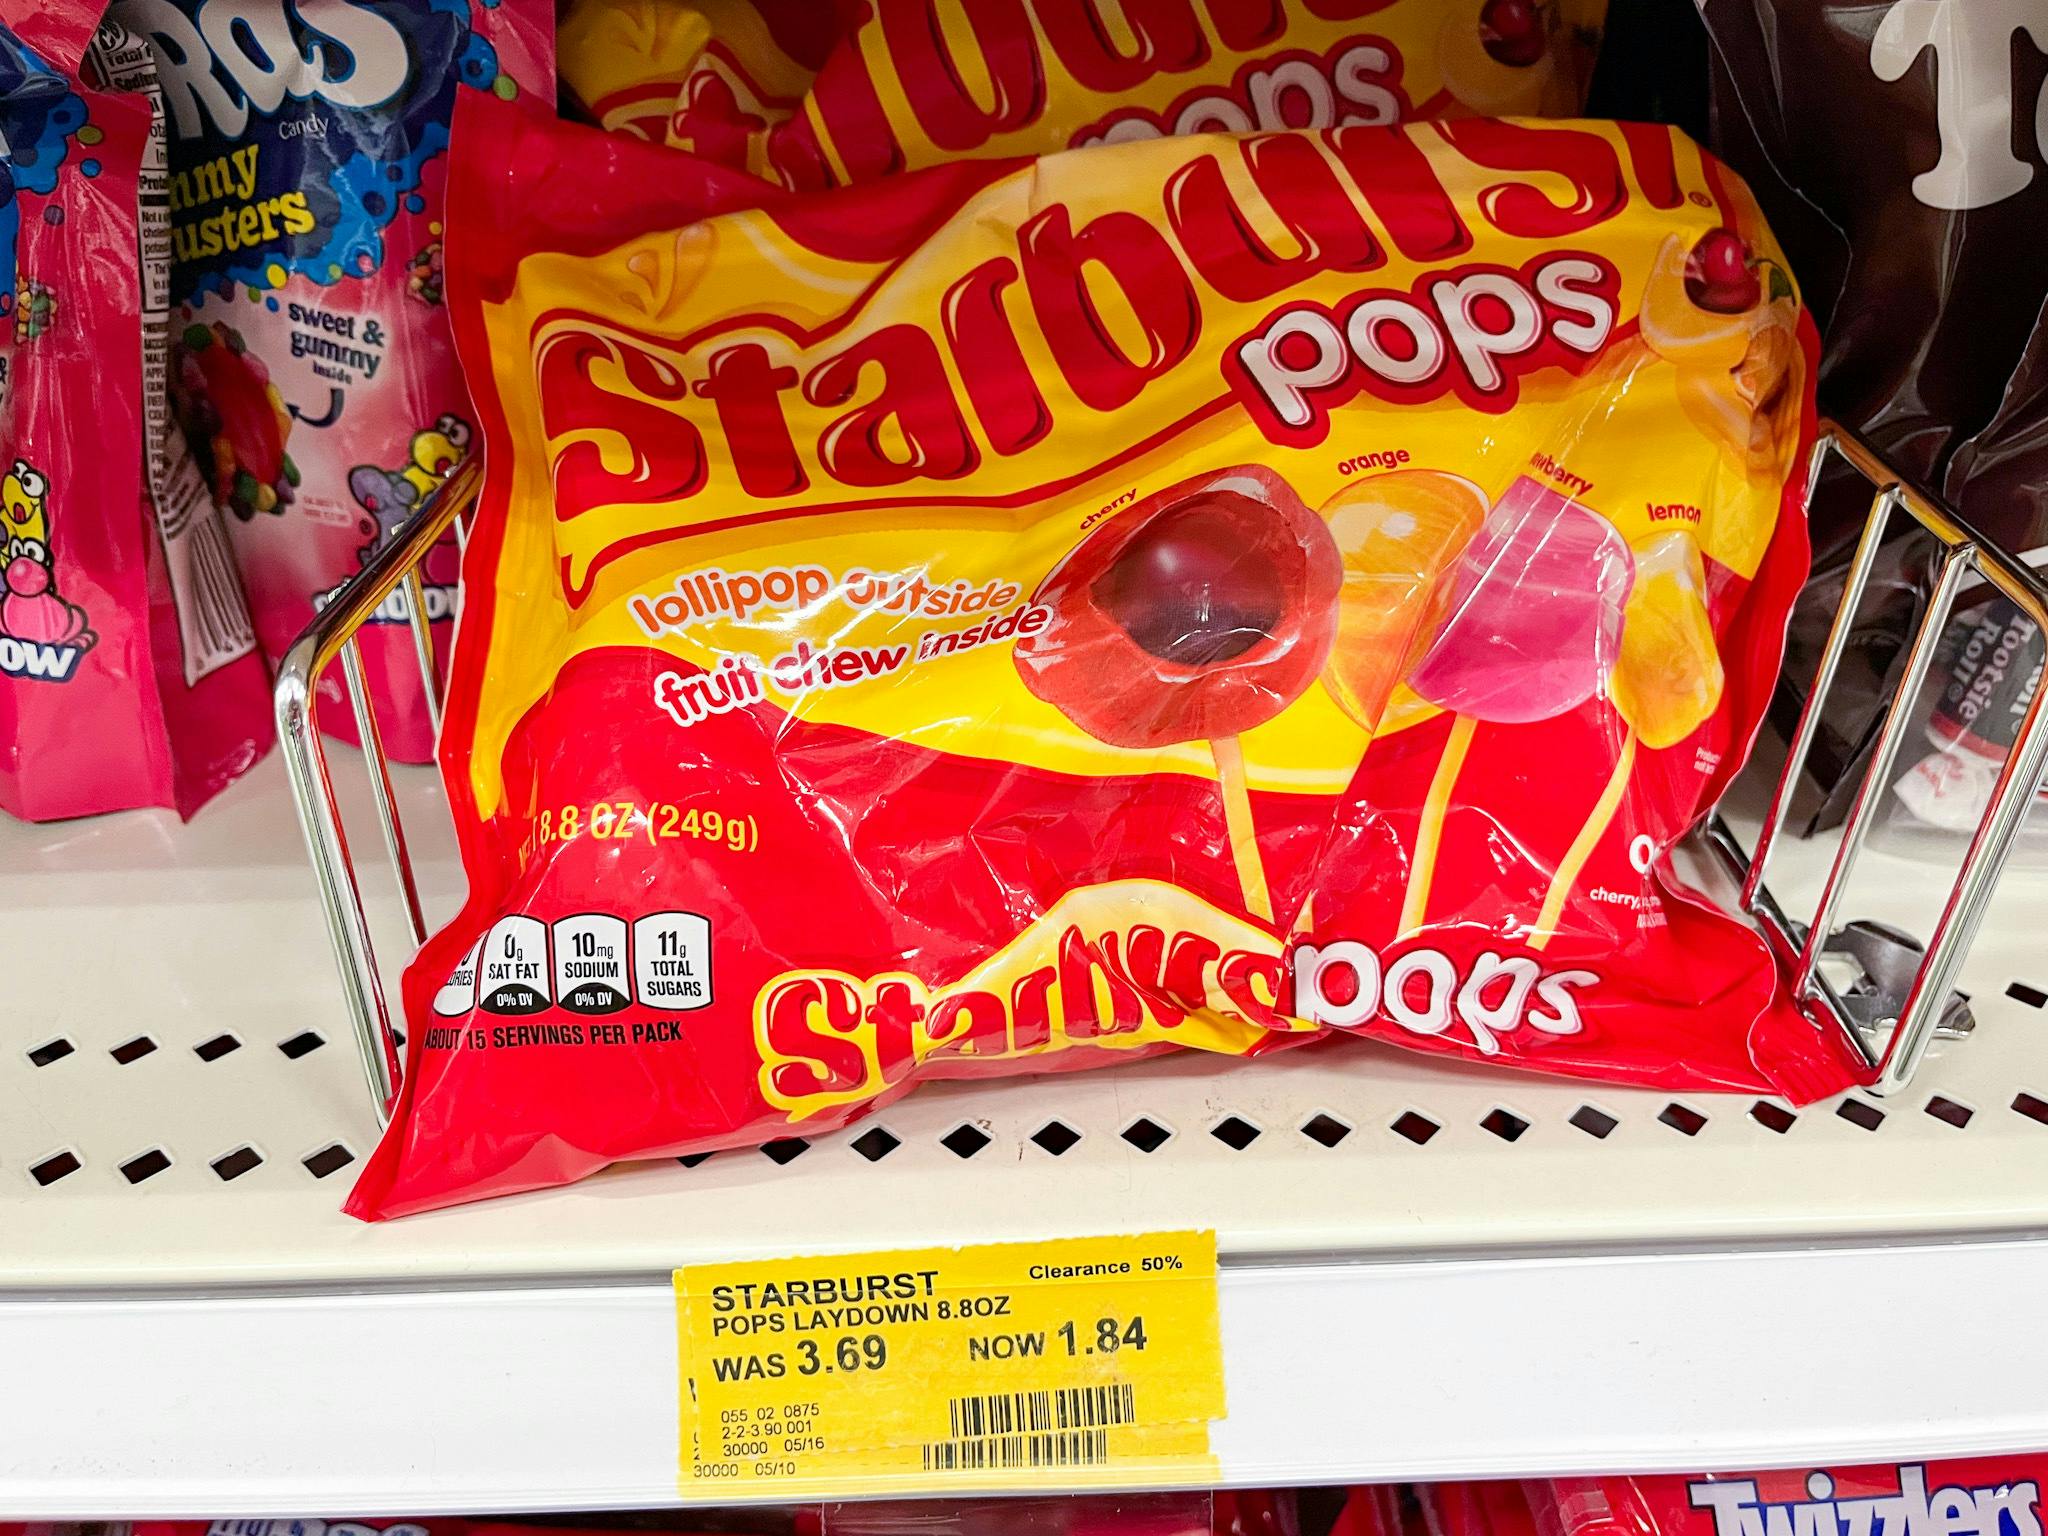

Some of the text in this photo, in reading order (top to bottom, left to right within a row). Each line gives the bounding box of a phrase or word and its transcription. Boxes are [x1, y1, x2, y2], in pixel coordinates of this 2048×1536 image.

[279, 113, 329, 139] Candy
[170, 191, 315, 262] usters
[288, 302, 385, 348] sweet &
[291, 329, 382, 380] gummy
[1239, 258, 1613, 428] pops
[312, 362, 353, 386] inside
[1337, 447, 1411, 477] orange
[1079, 487, 1138, 532] cherry
[1646, 501, 1702, 526] lemon
[630, 567, 1018, 634] lollipop outside
[658, 604, 1049, 723] fruit chew inside
[1958, 613, 2038, 720] Tootsie
[540, 801, 759, 853] 8.8 OZ (249g)
[488, 962, 540, 980] SAT FAT
[564, 961, 619, 979] SODIUM
[651, 960, 694, 977] TOTAL
[496, 992, 534, 1008] 0% DV
[575, 991, 612, 1007] 0% DV
[647, 980, 702, 997] SUGARS
[1295, 940, 1601, 1055] pops
[425, 1021, 682, 1050] ABOUT 15 SERVINGS PER PACK
[1029, 1254, 1183, 1281] Clearance 50%
[712, 1270, 939, 1312] STARBURST
[713, 1295, 1012, 1337] POPS LAYDOWN 8.8OZ
[969, 1316, 1148, 1362] NOW 1.84
[712, 1333, 887, 1383] WAS 3.69
[721, 1402, 820, 1424] 055 02 0875
[786, 1419, 813, 1434] 001
[723, 1436, 826, 1457] 30000 05/16
[693, 1461, 796, 1478] 30000 05/10
